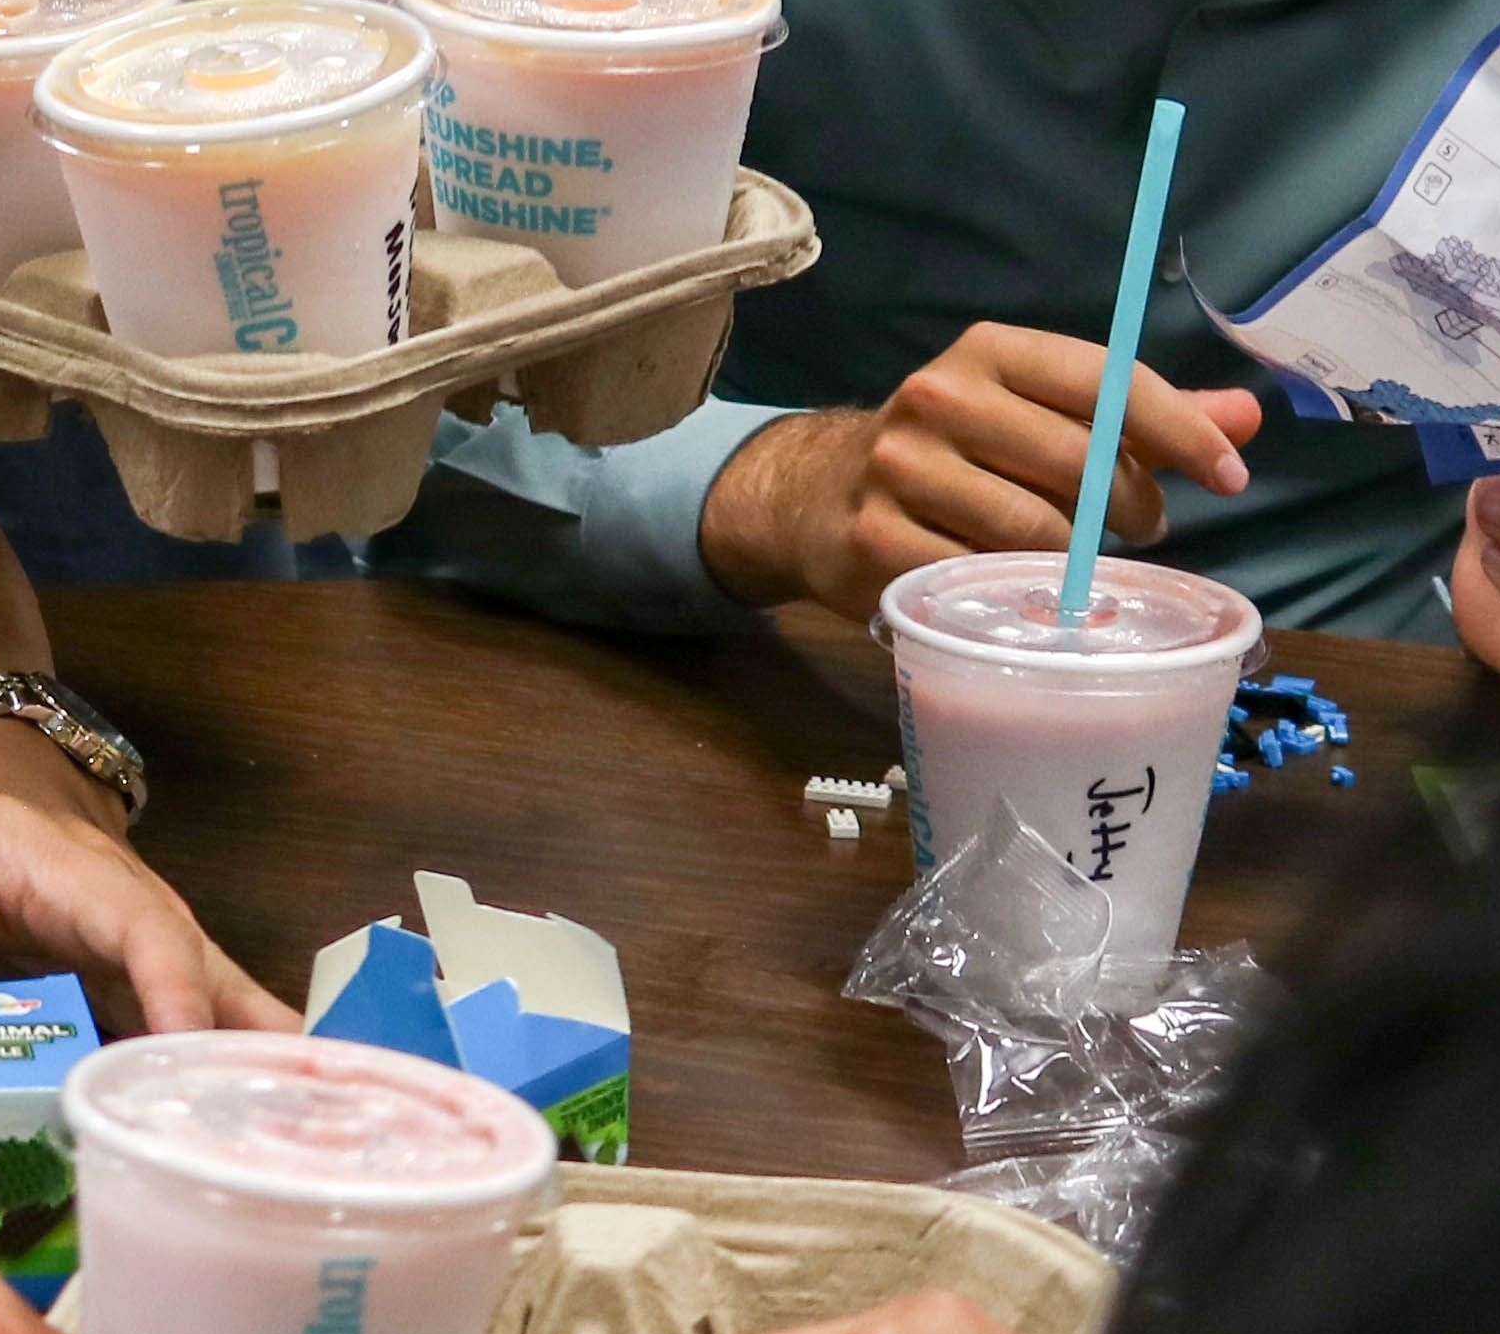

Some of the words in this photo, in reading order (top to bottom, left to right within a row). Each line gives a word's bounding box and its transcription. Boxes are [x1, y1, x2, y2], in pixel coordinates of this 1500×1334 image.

[427, 107, 614, 172] SUNSHINE,
[430, 139, 553, 198] SPREAD
[218, 177, 300, 354] tropicalC
